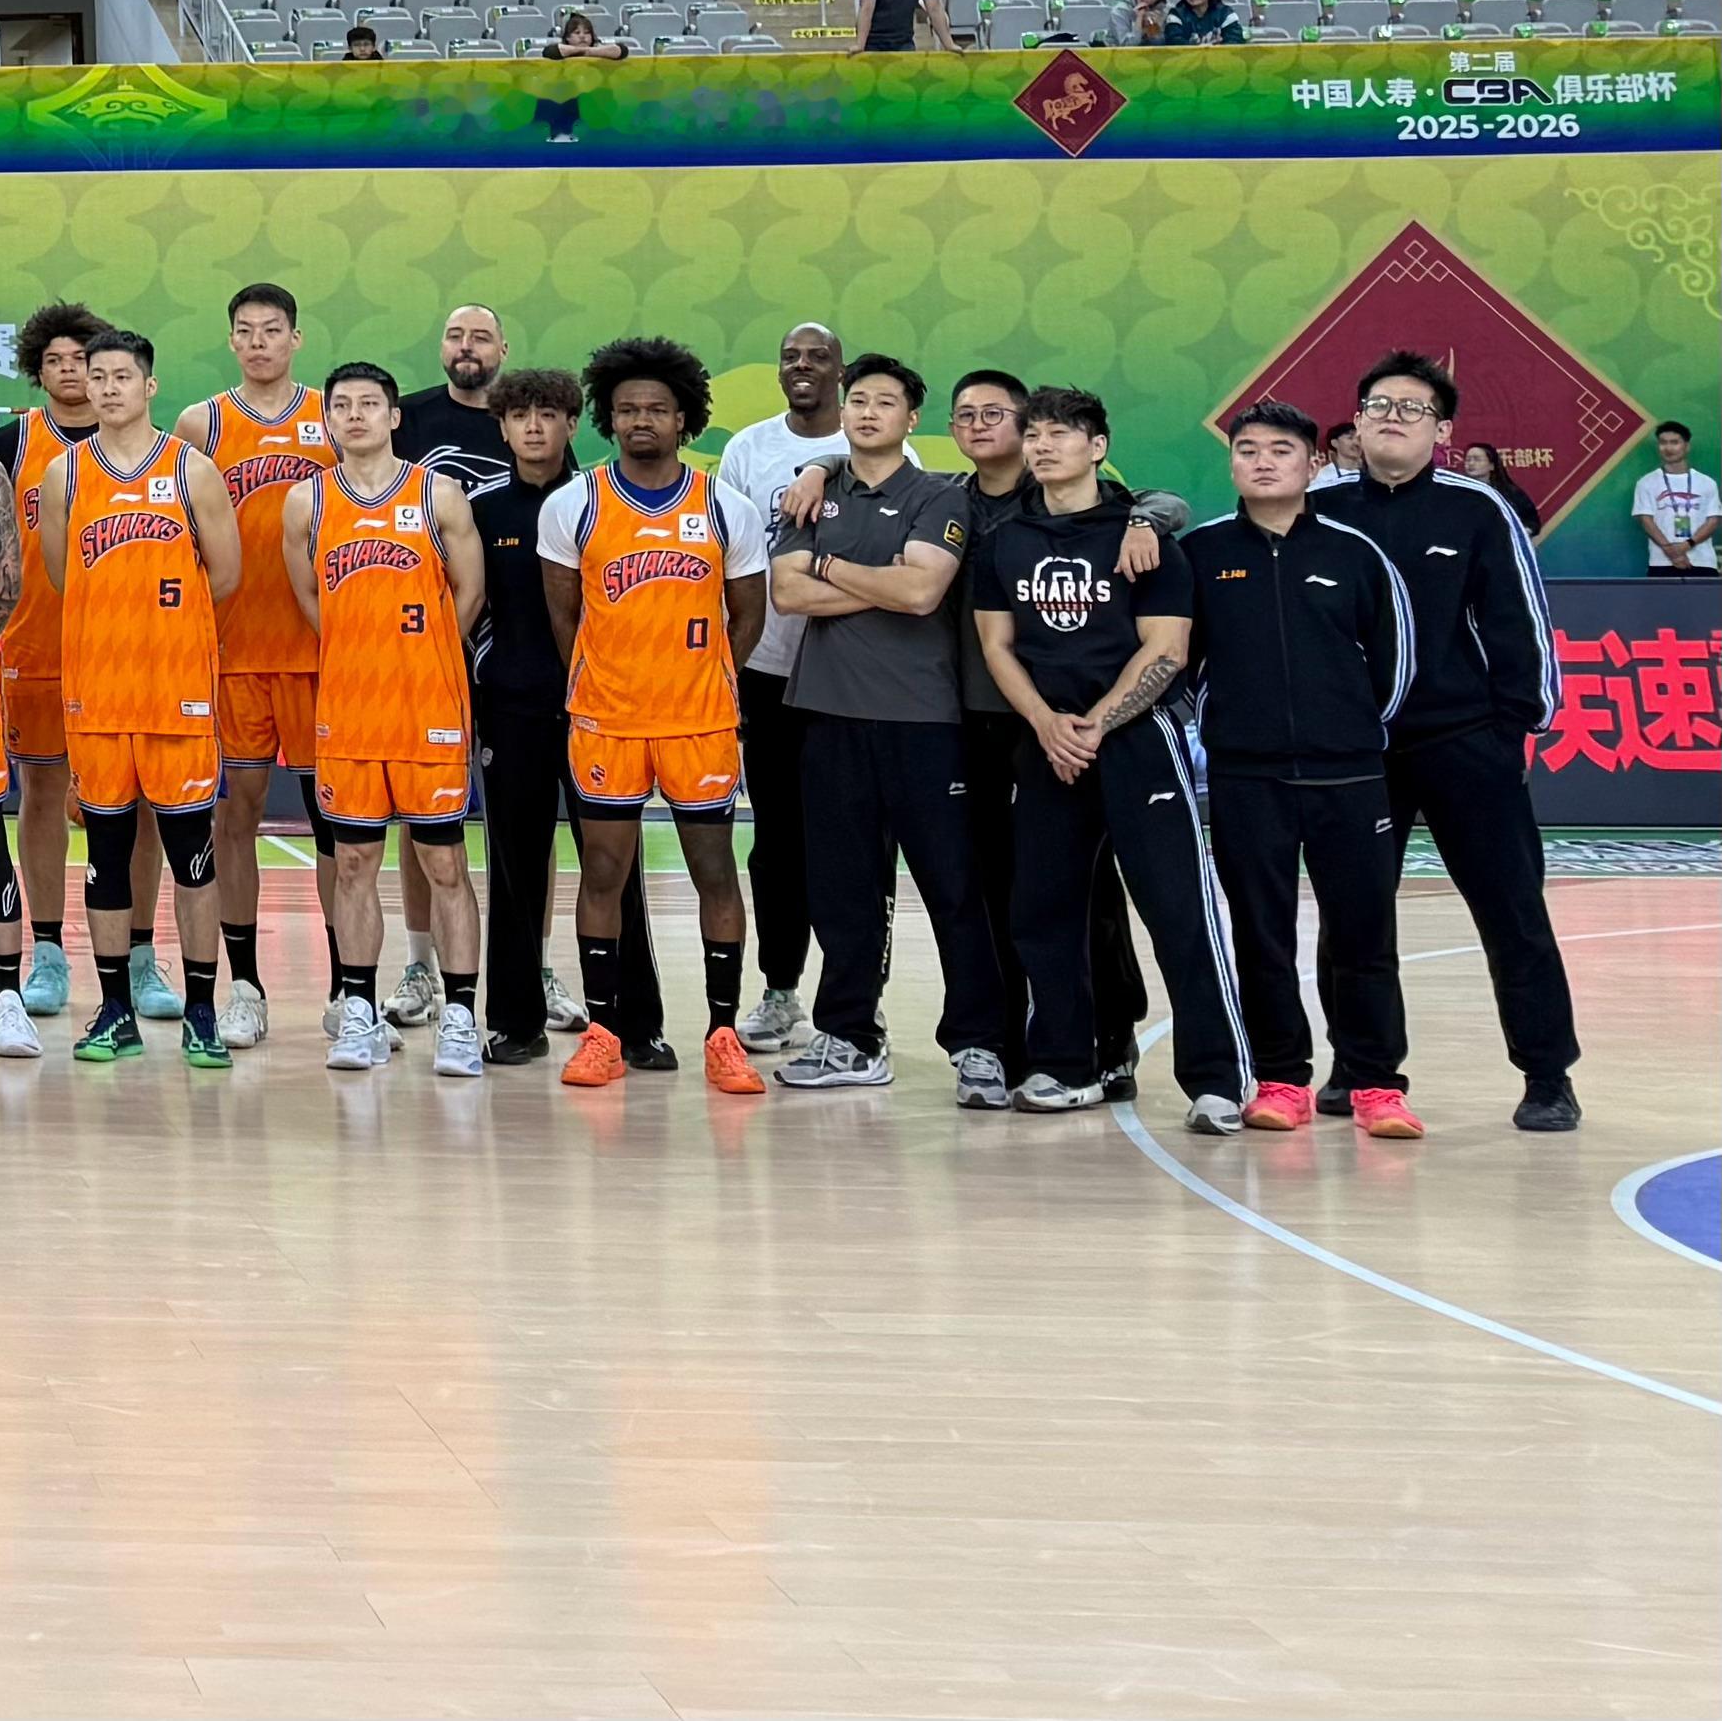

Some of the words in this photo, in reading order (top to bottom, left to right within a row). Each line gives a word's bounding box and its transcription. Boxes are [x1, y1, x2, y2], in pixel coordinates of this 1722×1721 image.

[1448, 51, 1515, 74] 第二届
[1396, 113, 1580, 141] 2025-2026
[79, 511, 184, 569] SHARKS
[324, 539, 422, 593] SHARKS
[602, 550, 713, 604] SHARKS
[158, 578, 183, 608] 5
[1016, 579, 1112, 603] SHARKS
[400, 604, 425, 634] 3
[686, 617, 709, 651] 0
